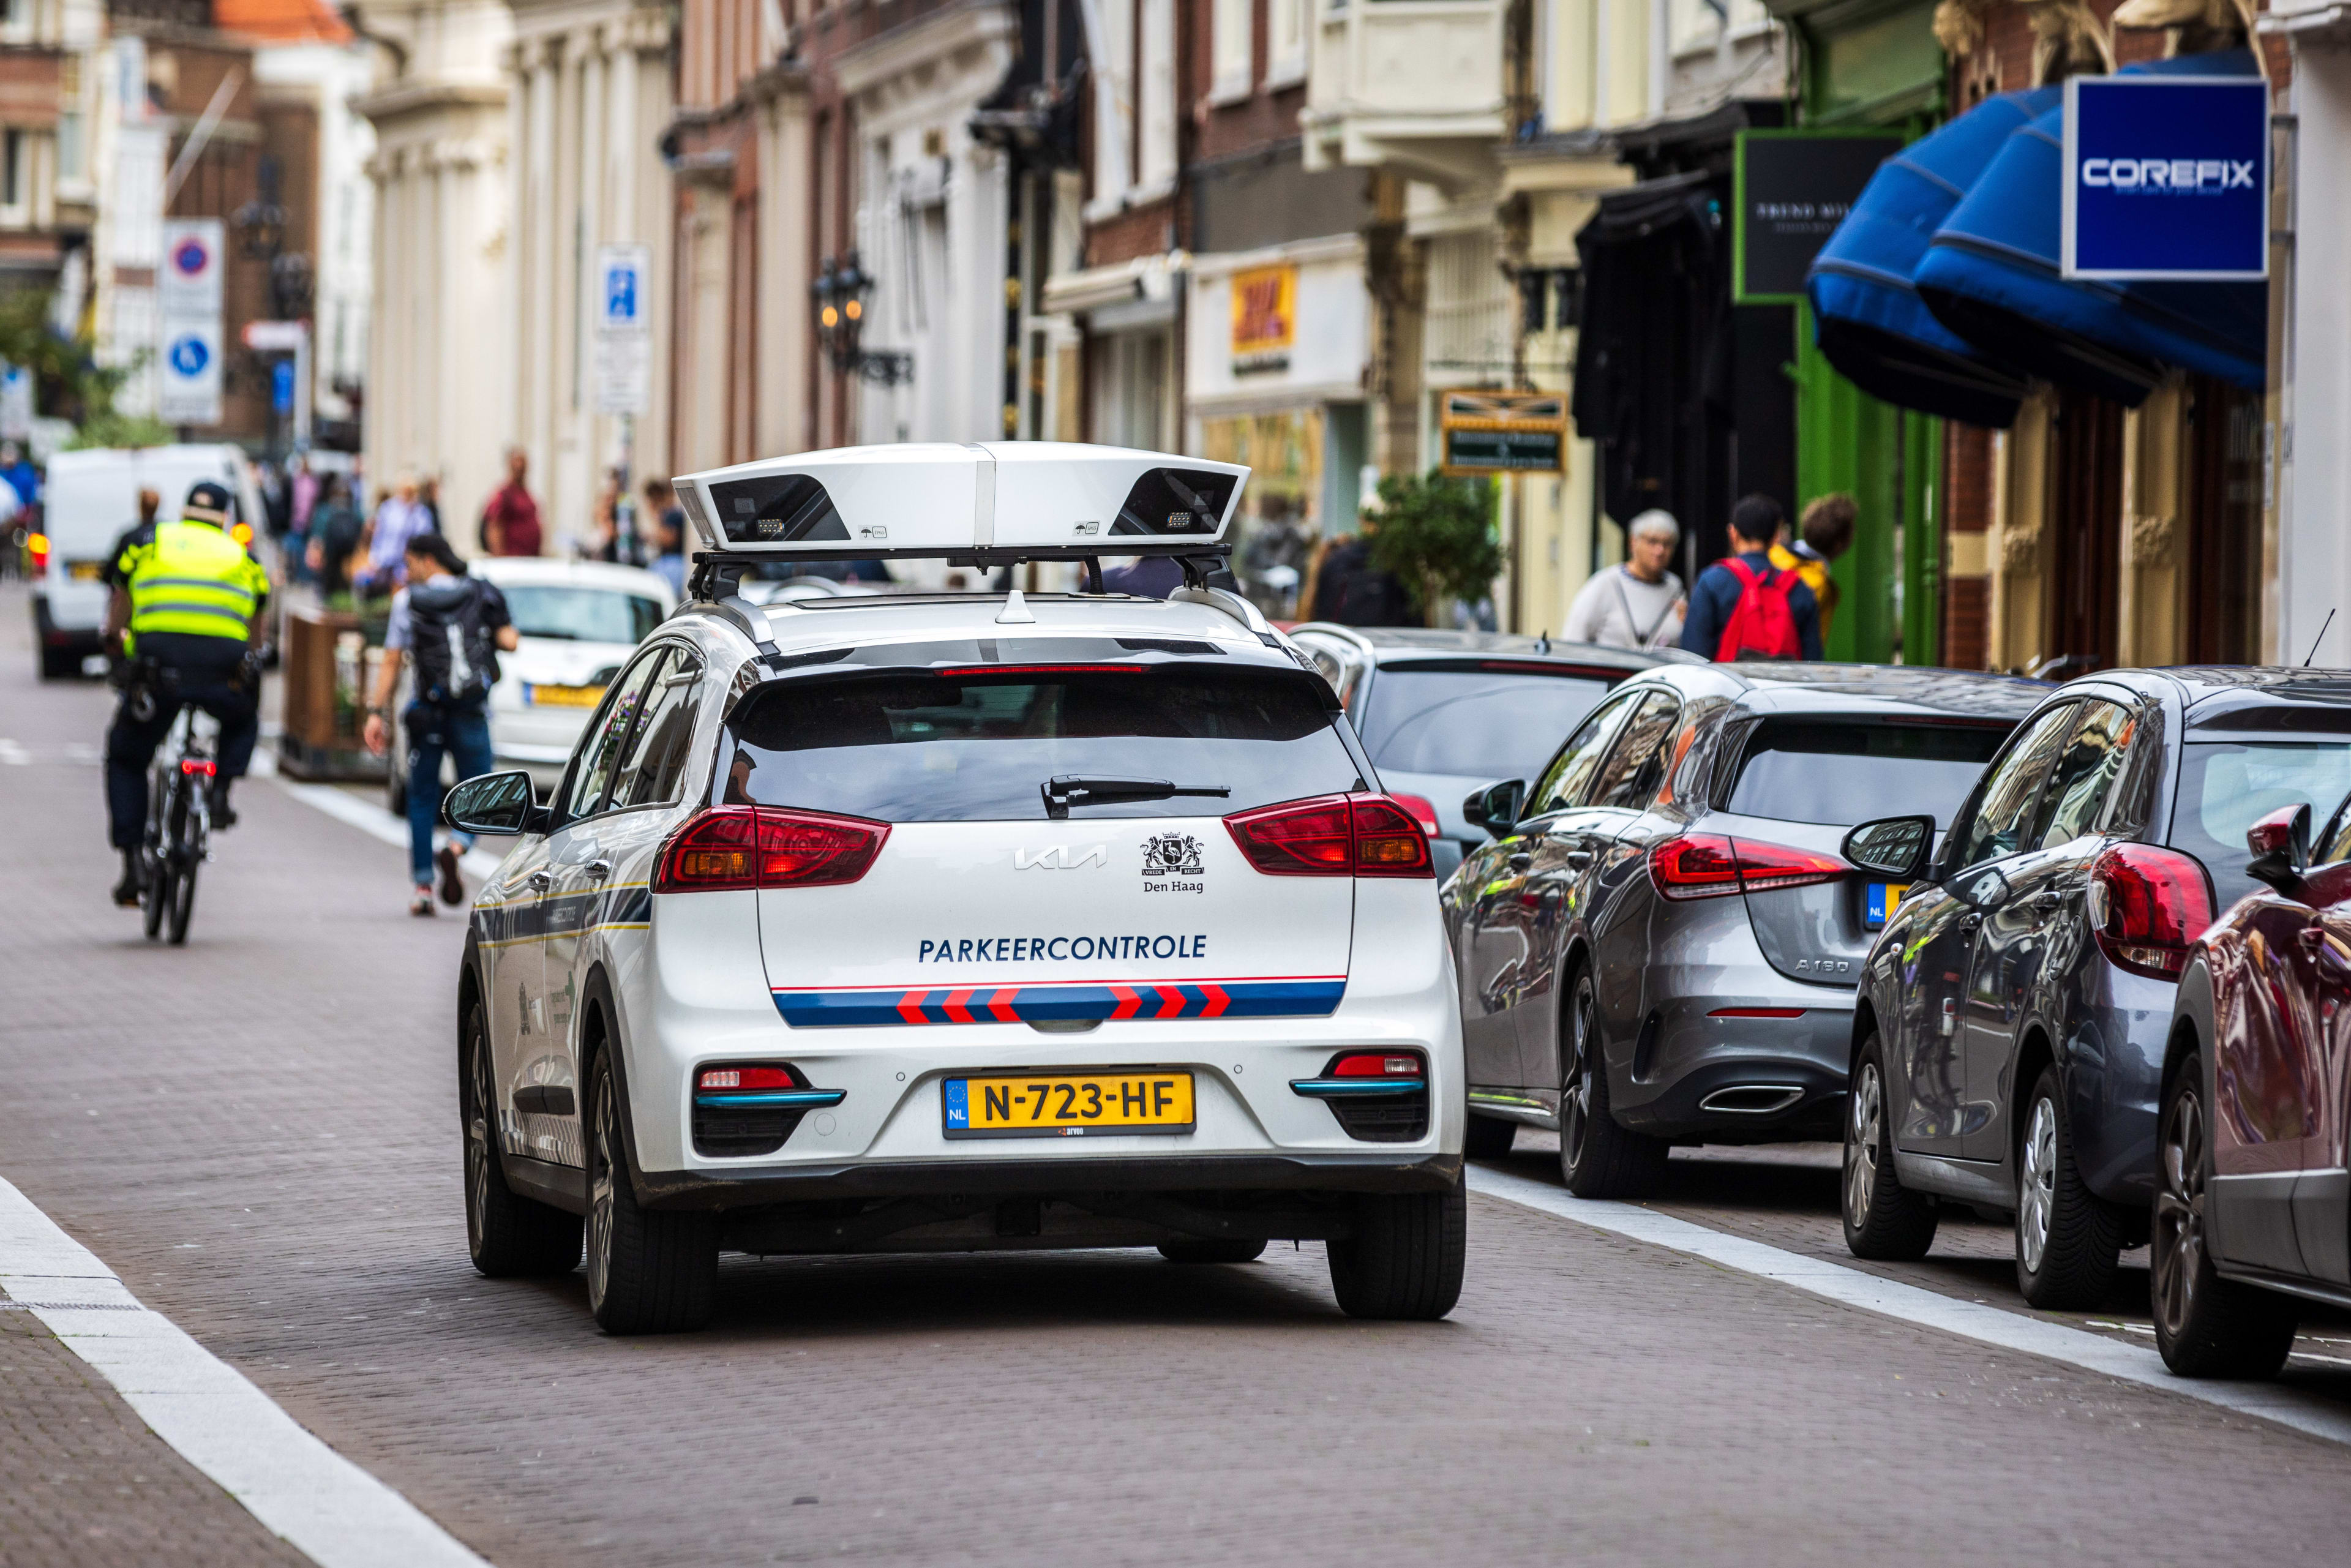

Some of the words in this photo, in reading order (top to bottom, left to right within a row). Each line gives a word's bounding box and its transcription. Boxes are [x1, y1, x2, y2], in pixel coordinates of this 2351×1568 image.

[2082, 158, 2254, 189] COREFIX
[1144, 882, 1168, 892] Den
[1171, 881, 1203, 894] Haag
[1870, 907, 1884, 917] NL
[918, 935, 1207, 962] PARKEERCONTROLE
[1795, 959, 1810, 970] A
[984, 1081, 1174, 1121] N-723-HF
[949, 1109, 966, 1120] NL
